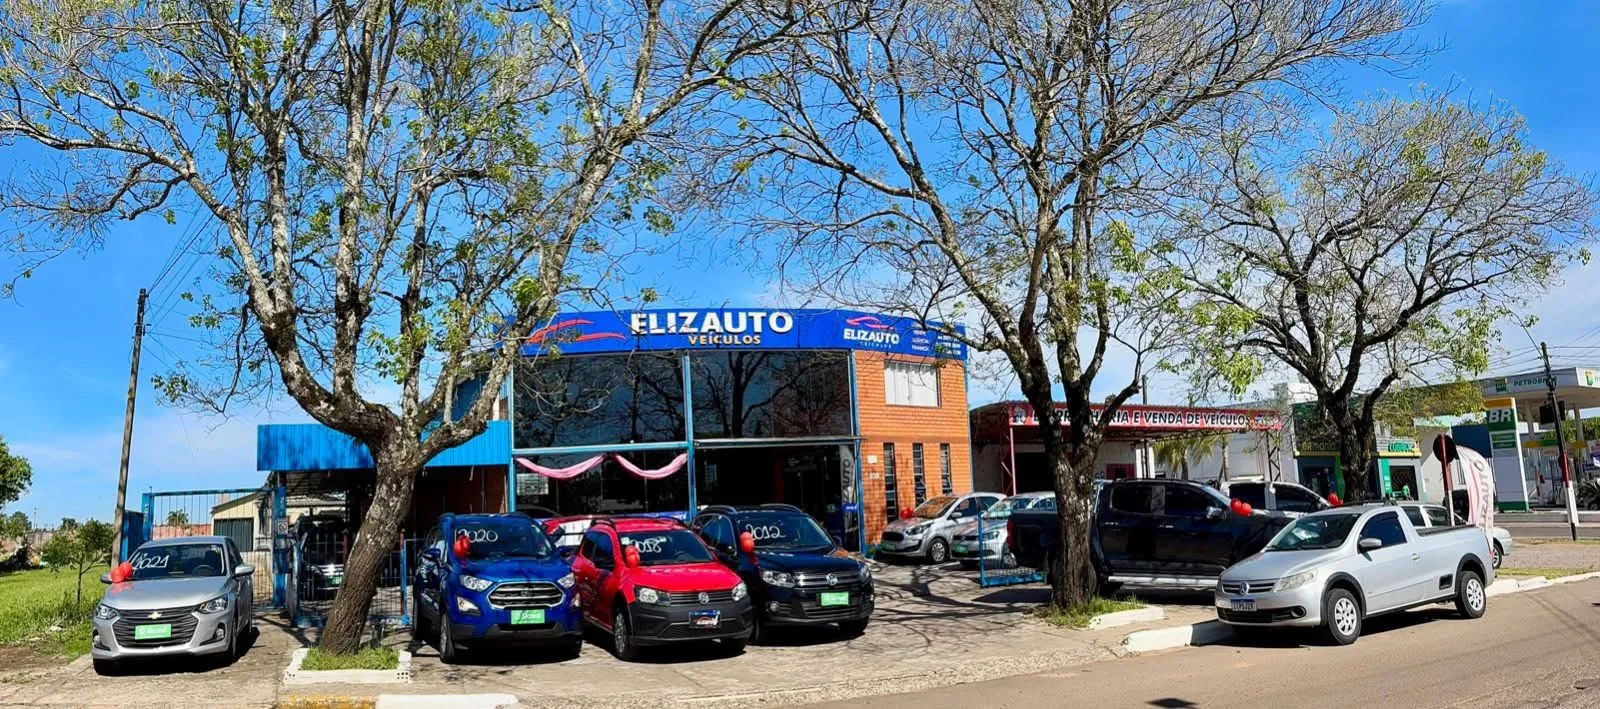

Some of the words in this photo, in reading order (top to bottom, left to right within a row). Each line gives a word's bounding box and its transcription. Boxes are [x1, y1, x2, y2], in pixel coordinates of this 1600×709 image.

[630, 311, 793, 335] ELIZAUTO
[688, 333, 761, 346] VEÍCULOS
[843, 327, 900, 345] ELIZAUTO
[1134, 412, 1140, 424] E
[1143, 412, 1183, 425] VENDA
[1186, 413, 1200, 425] DE
[1488, 408, 1512, 423] BR
